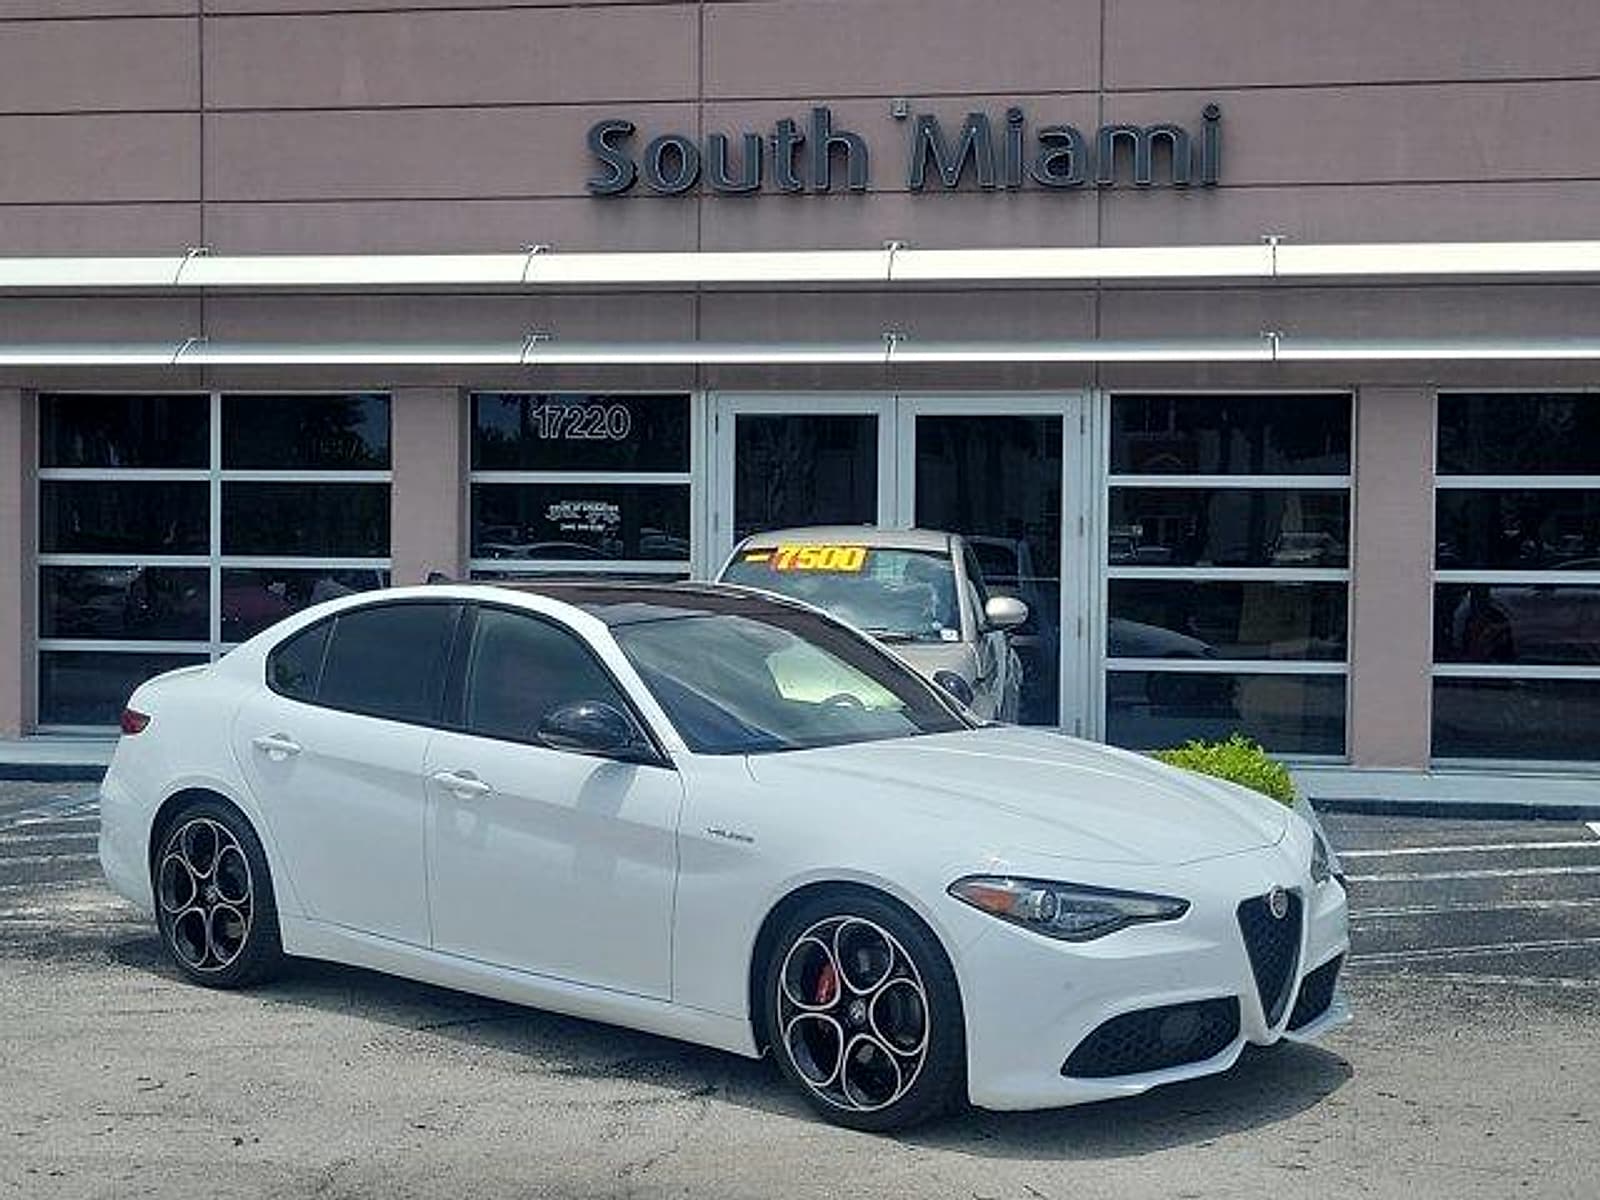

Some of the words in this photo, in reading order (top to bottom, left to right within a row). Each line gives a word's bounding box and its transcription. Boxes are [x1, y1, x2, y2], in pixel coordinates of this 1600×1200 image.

[586, 106, 870, 195] South
[908, 103, 1222, 192] Miami
[533, 404, 631, 440] 17220
